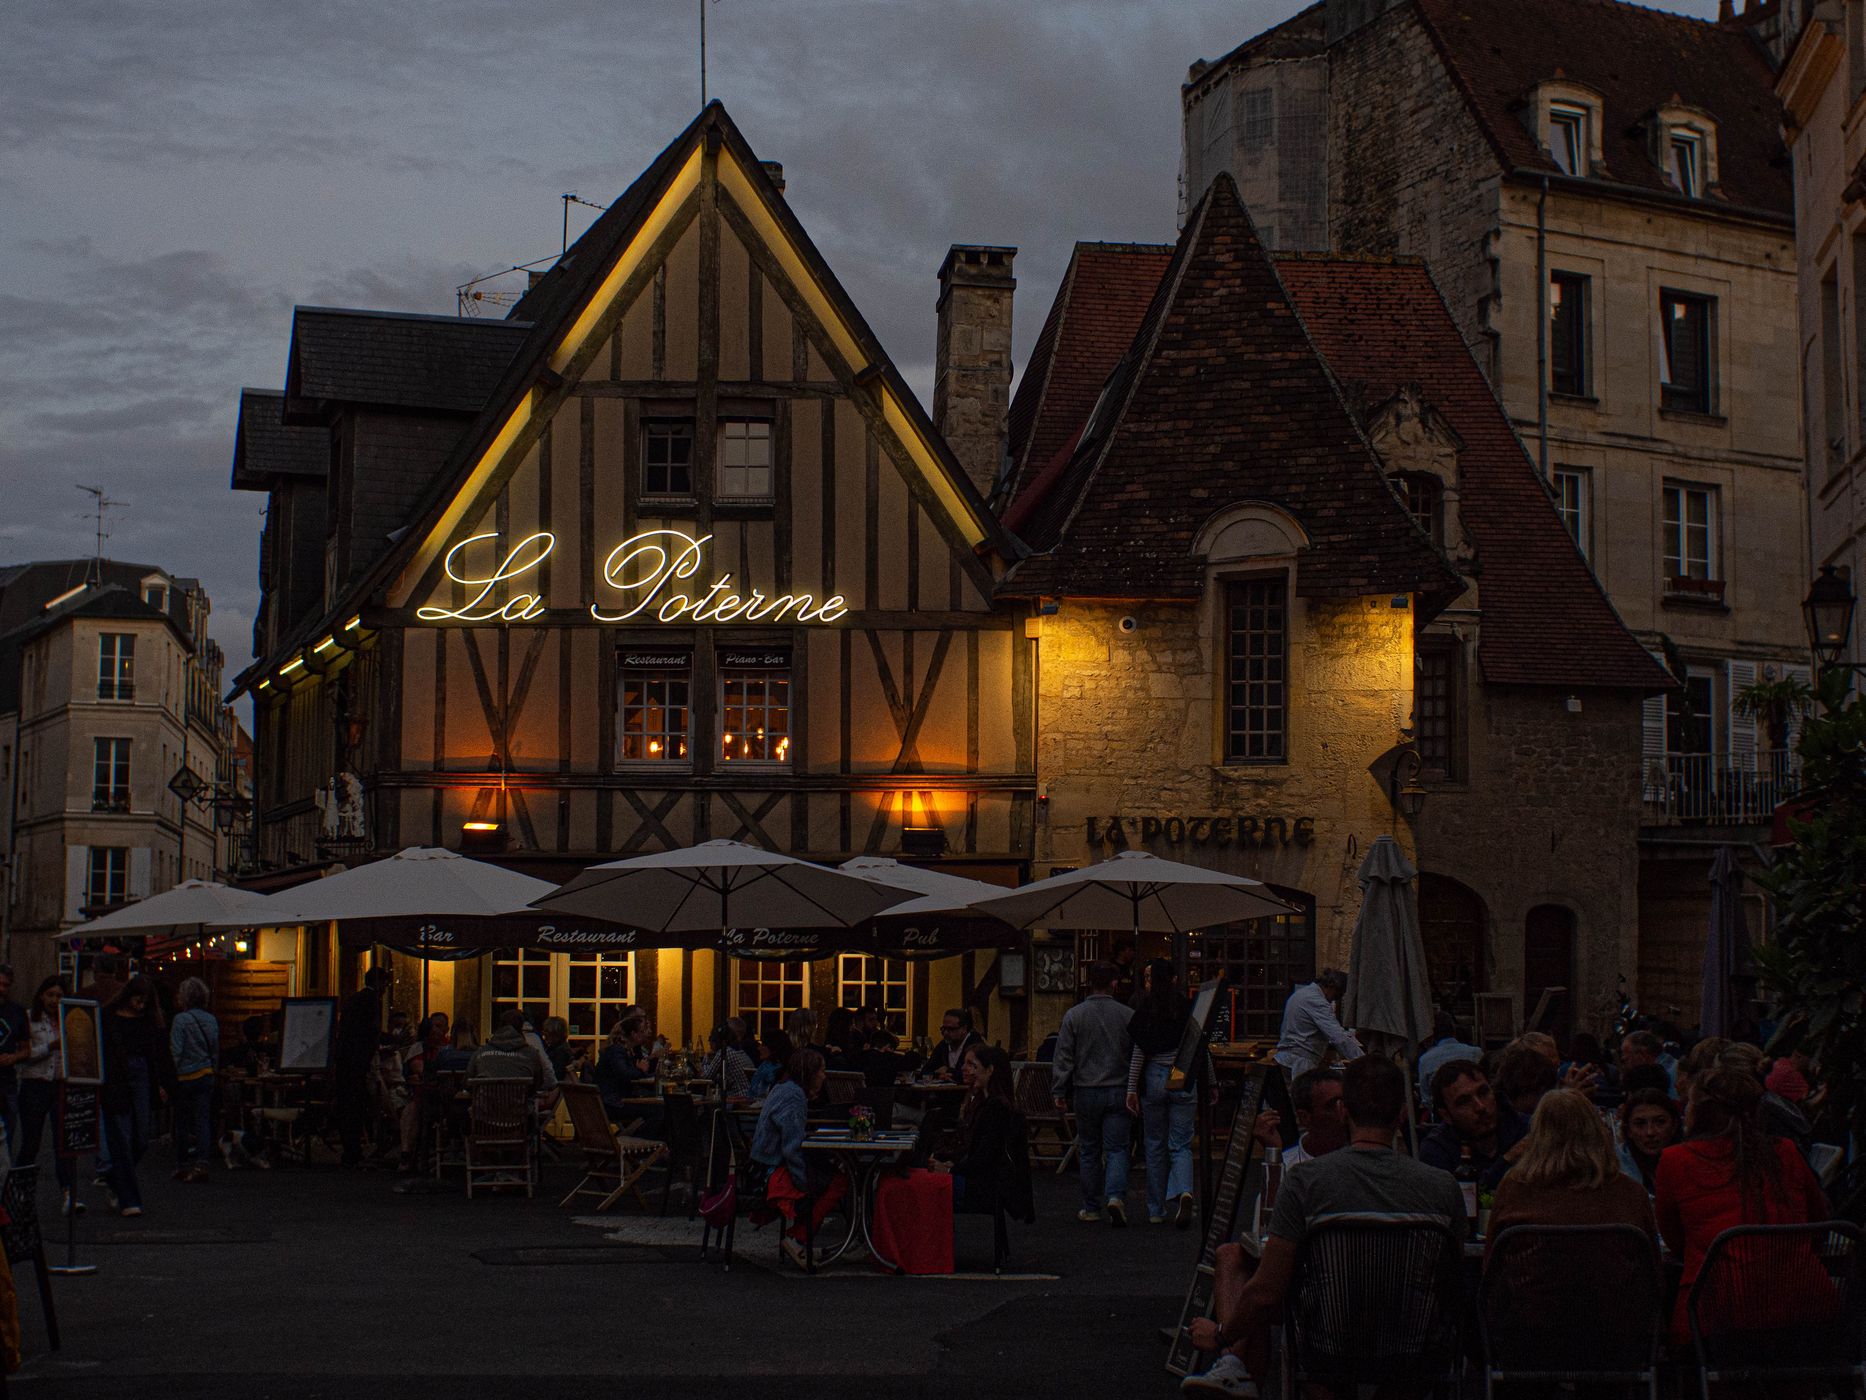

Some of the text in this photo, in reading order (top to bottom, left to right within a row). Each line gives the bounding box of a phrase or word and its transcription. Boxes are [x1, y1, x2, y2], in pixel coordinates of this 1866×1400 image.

[416, 530, 849, 622] La Poterne
[624, 652, 687, 665] Restaurant
[725, 652, 784, 665] Piano-Bar
[1086, 816, 1315, 848] LA POTERNE
[419, 924, 454, 942] Bar
[537, 925, 637, 944] Restaurant
[752, 928, 820, 945] Poterne
[902, 928, 940, 945] Pub
